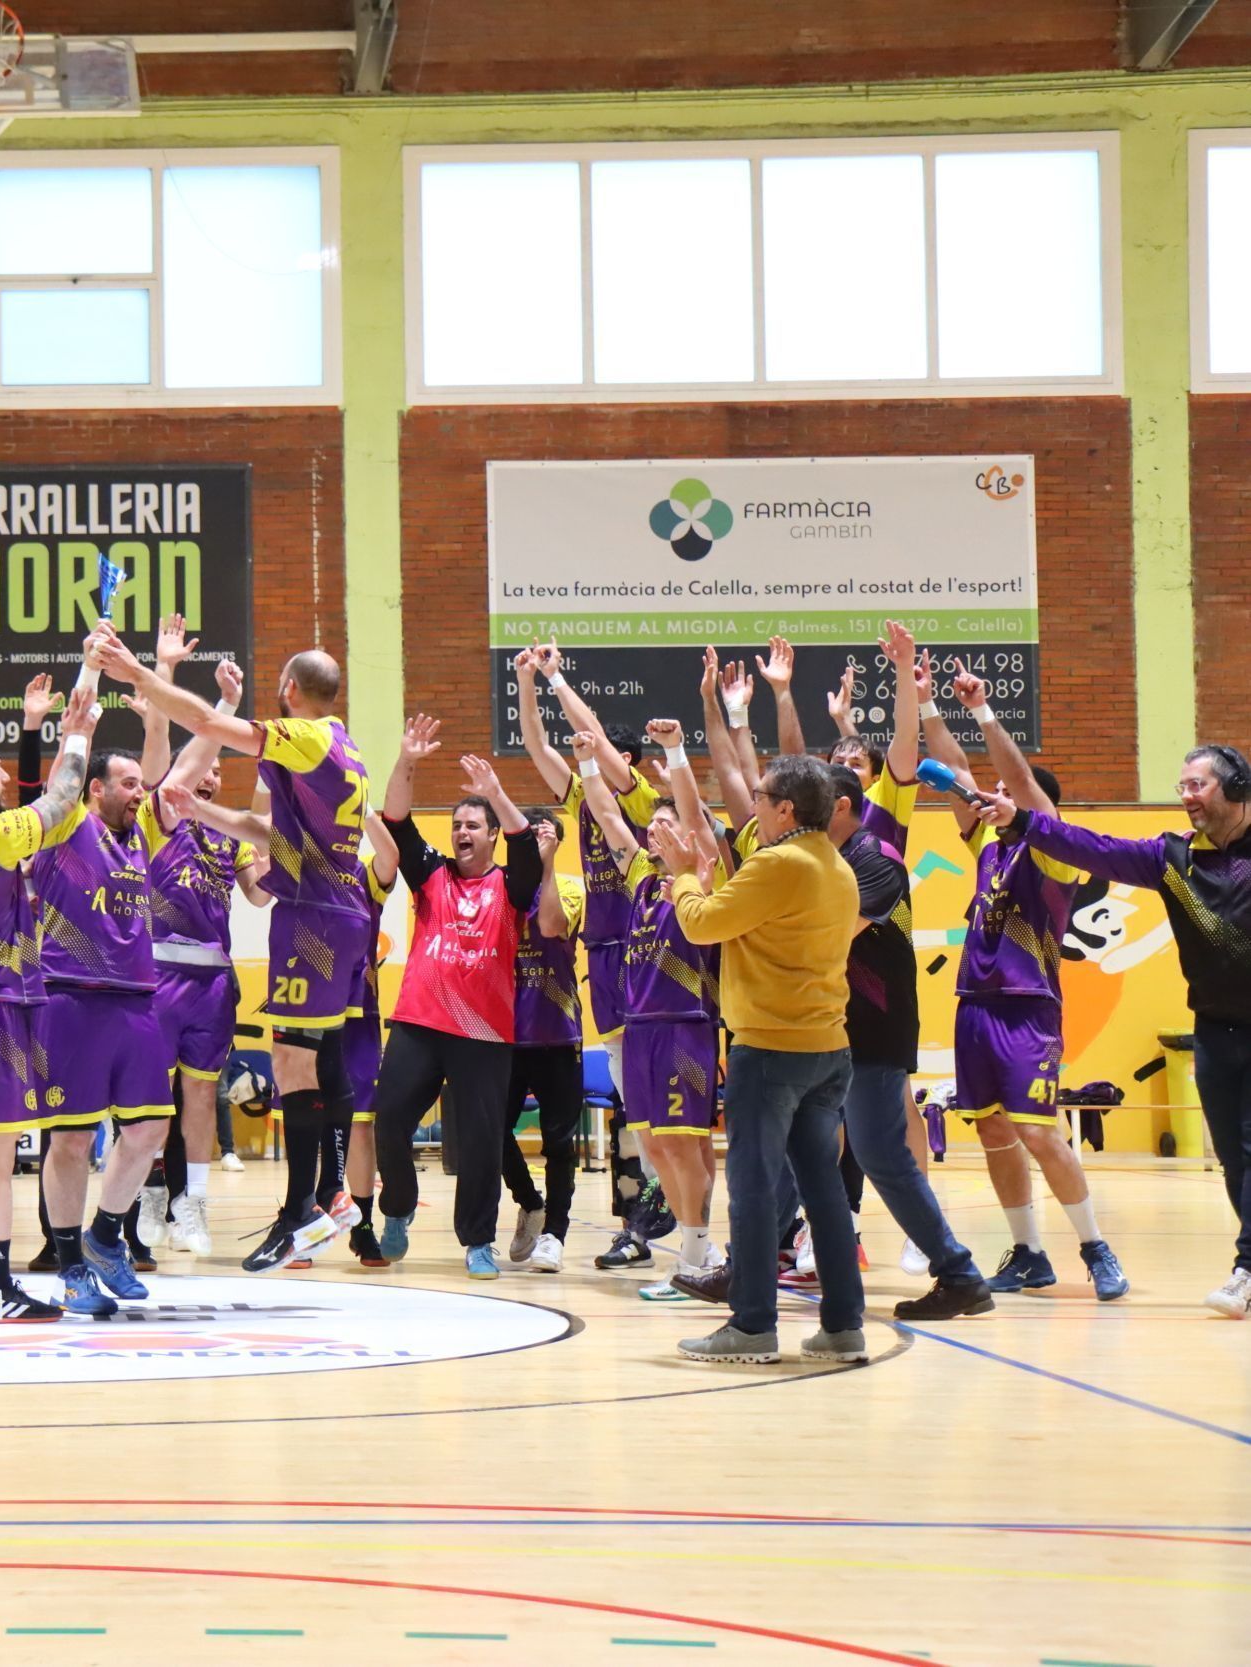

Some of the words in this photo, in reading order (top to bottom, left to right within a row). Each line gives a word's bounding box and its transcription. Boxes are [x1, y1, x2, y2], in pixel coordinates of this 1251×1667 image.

[744, 497, 871, 519] FARMÀCIA
[503, 582, 524, 597] La
[529, 583, 568, 597] teva
[574, 580, 655, 597] farmàcia
[661, 580, 683, 596] de
[688, 579, 759, 597] Calella,
[764, 581, 831, 598] sempre
[837, 578, 854, 594] al
[859, 579, 914, 594] costat
[920, 577, 942, 594] de
[948, 576, 1023, 597] l'esport!
[504, 621, 533, 636] NO
[538, 620, 631, 636] TANQUEM
[638, 620, 661, 635] AL
[666, 619, 738, 634] MIGDIA
[778, 619, 844, 636] Balmes,
[849, 619, 872, 634] 151
[956, 618, 1023, 635] Calella)
[10, 653, 50, 664] MOTORS
[966, 653, 987, 673] 14
[994, 652, 1025, 673] 98
[581, 681, 601, 695] 9h
[605, 685, 614, 695] a
[618, 681, 644, 695] 21h
[272, 975, 308, 1005] 20
[1027, 1077, 1057, 1106] 41
[667, 1092, 684, 1117] 2
[24, 1350, 433, 1358] HANDBALL
